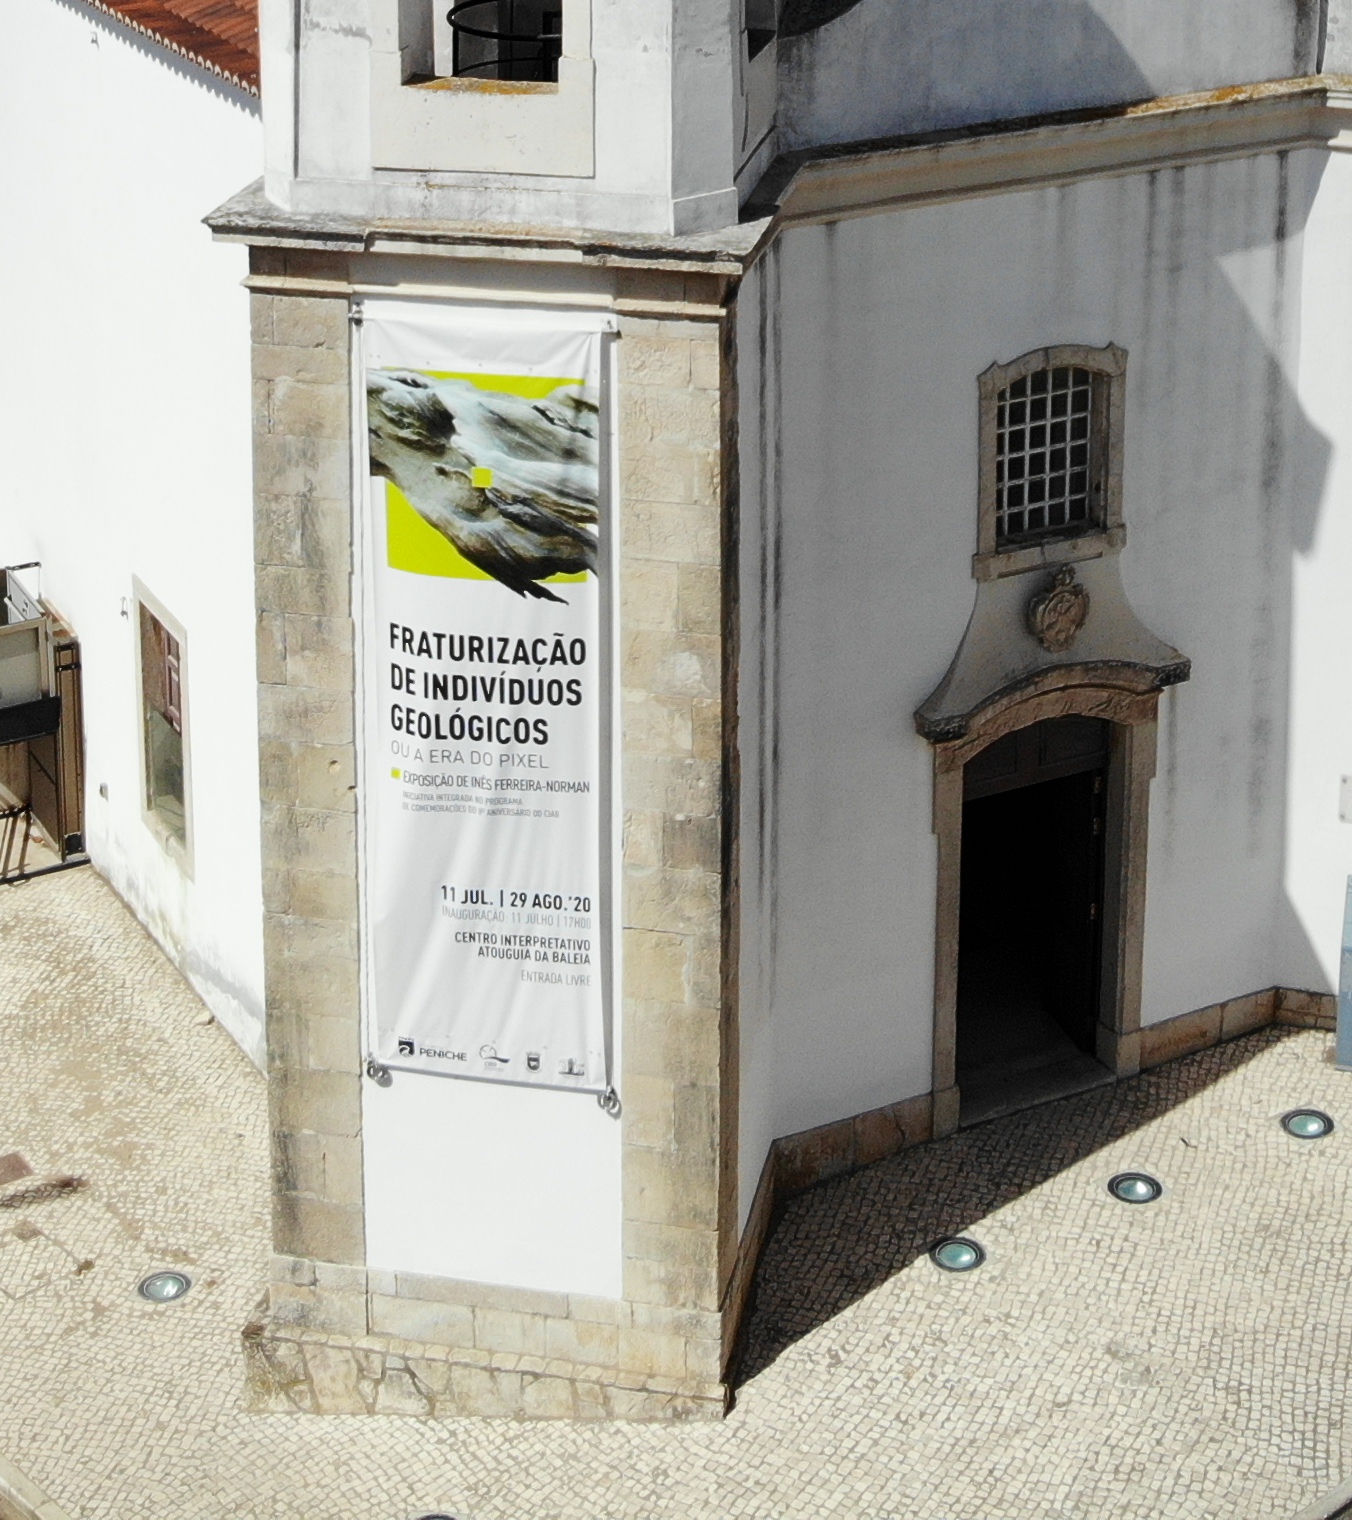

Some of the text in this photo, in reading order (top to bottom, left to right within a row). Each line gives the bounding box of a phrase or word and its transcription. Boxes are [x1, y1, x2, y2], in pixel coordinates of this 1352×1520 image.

[390, 622, 586, 672] FRATURIZAÇÃO
[391, 662, 582, 706] DE INDIVÍDUOS
[391, 703, 549, 745] GEOLÓGICOS
[391, 740, 550, 769] OU A ERA DO PIXEL
[403, 770, 590, 793] EXPOSIÇÃO DE INÊS FERREIRA-NORMAN
[441, 885, 455, 902] 11
[460, 889, 493, 906] JUL.
[510, 891, 527, 908] 29
[511, 911, 522, 925] 11
[525, 913, 554, 926] JULHO
[455, 931, 591, 951] CENTRO INTERPRETATIVO
[477, 946, 591, 965] ATOUGUIA DA BALEIA
[521, 969, 591, 987] ENTRADA LIVRE
[419, 1047, 468, 1062] PENICHE
